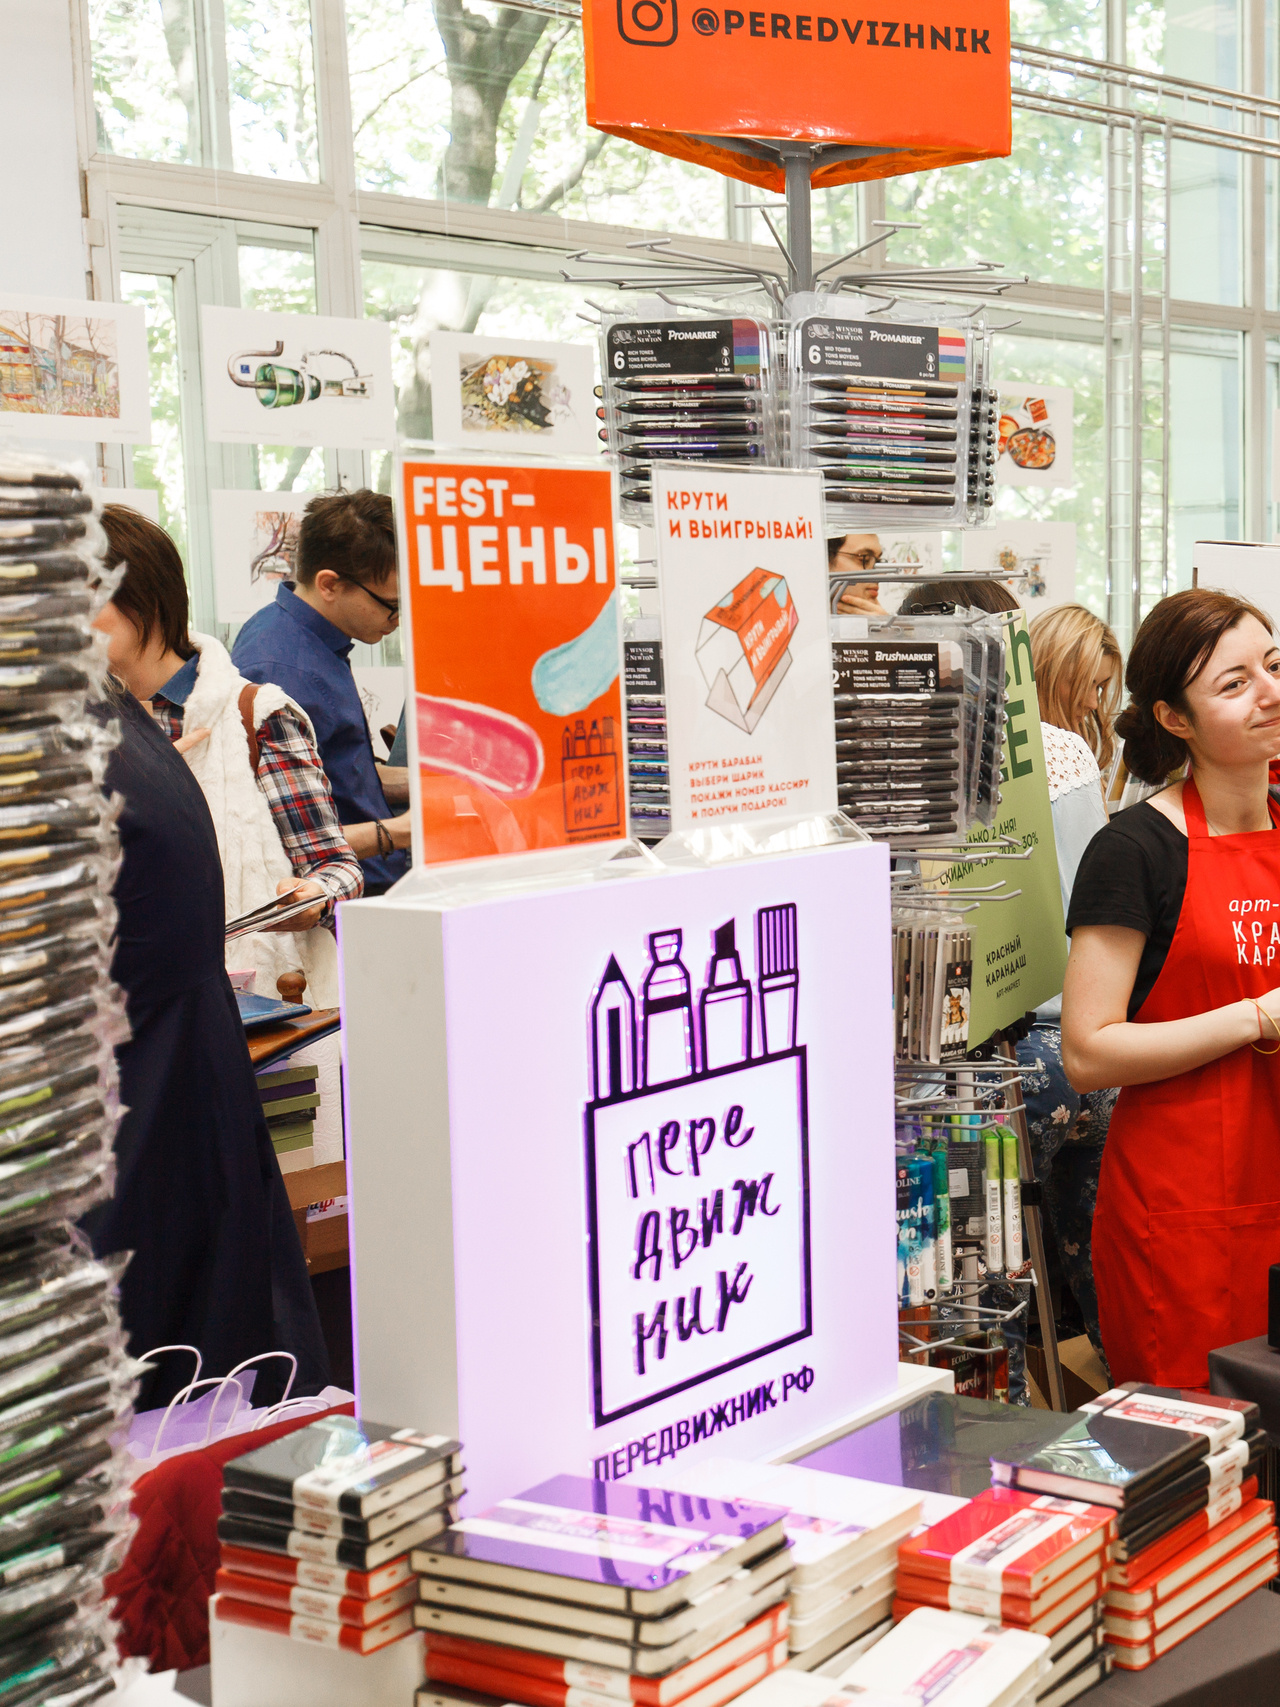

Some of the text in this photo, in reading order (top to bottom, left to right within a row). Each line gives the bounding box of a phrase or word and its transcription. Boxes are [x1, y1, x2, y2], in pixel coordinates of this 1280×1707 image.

[691, 8, 992, 55] @PEREDVIZHNIK
[835, 326, 863, 334] WINSOR
[835, 333, 863, 341] NEWTON
[613, 351, 625, 370] 6
[808, 345, 821, 364] 6
[413, 475, 535, 519] FEST-
[666, 491, 729, 512] КРУТИ
[669, 516, 813, 540] И ВЫИГРЫВАЙ!
[416, 525, 608, 593] ЦЕНЫ
[688, 755, 763, 772] КРУТИ БАРАБАН
[690, 770, 764, 788] ВЫБЕРИ ШАРИК
[690, 778, 809, 803] ПОКАЖИ НОМЕР КАССИРУ
[691, 797, 787, 818] И ПОЛУЧИ ПОДАРОК!
[985, 934, 1022, 967] КРАСНЫЙ
[947, 977, 969, 985] MICRON
[985, 954, 1027, 987] КАРАНДАШ
[995, 978, 1021, 999] АРТ-МАРКЕТ
